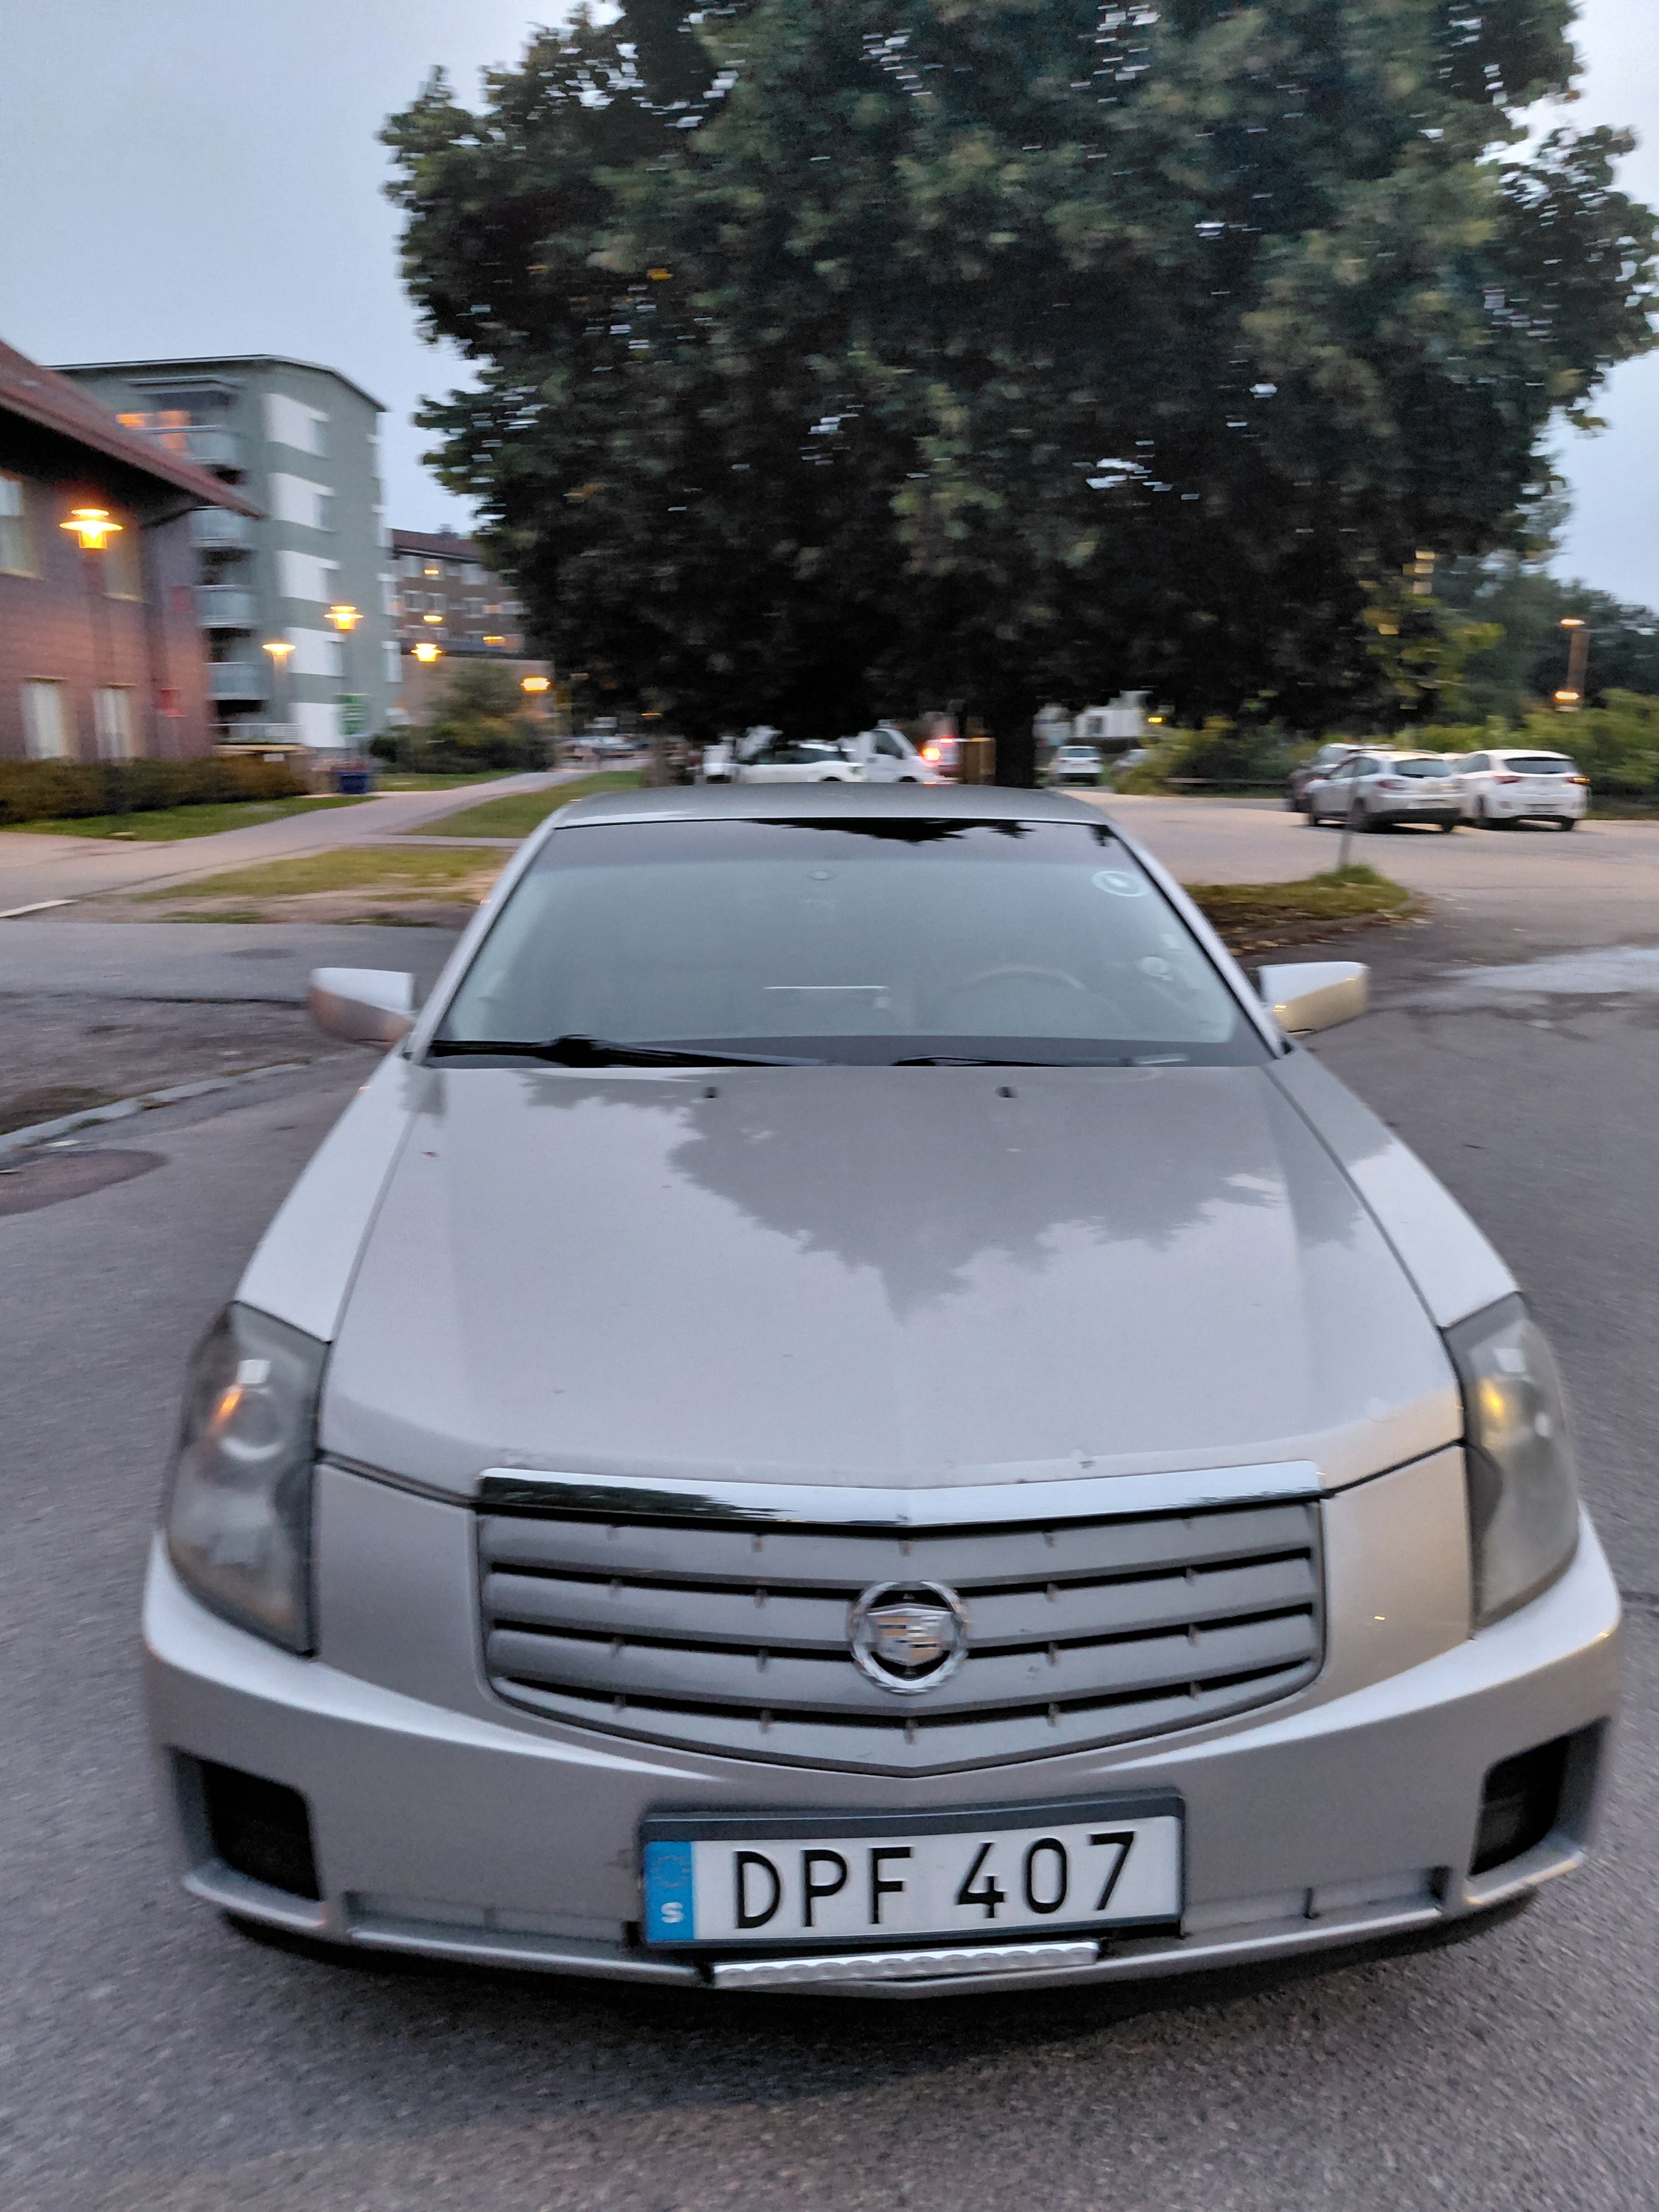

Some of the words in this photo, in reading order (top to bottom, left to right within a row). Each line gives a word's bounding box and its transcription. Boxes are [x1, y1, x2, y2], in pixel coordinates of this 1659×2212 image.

[733, 1846, 914, 1929] DPF
[955, 1831, 1136, 1919] 407
[661, 1901, 684, 1923] S
